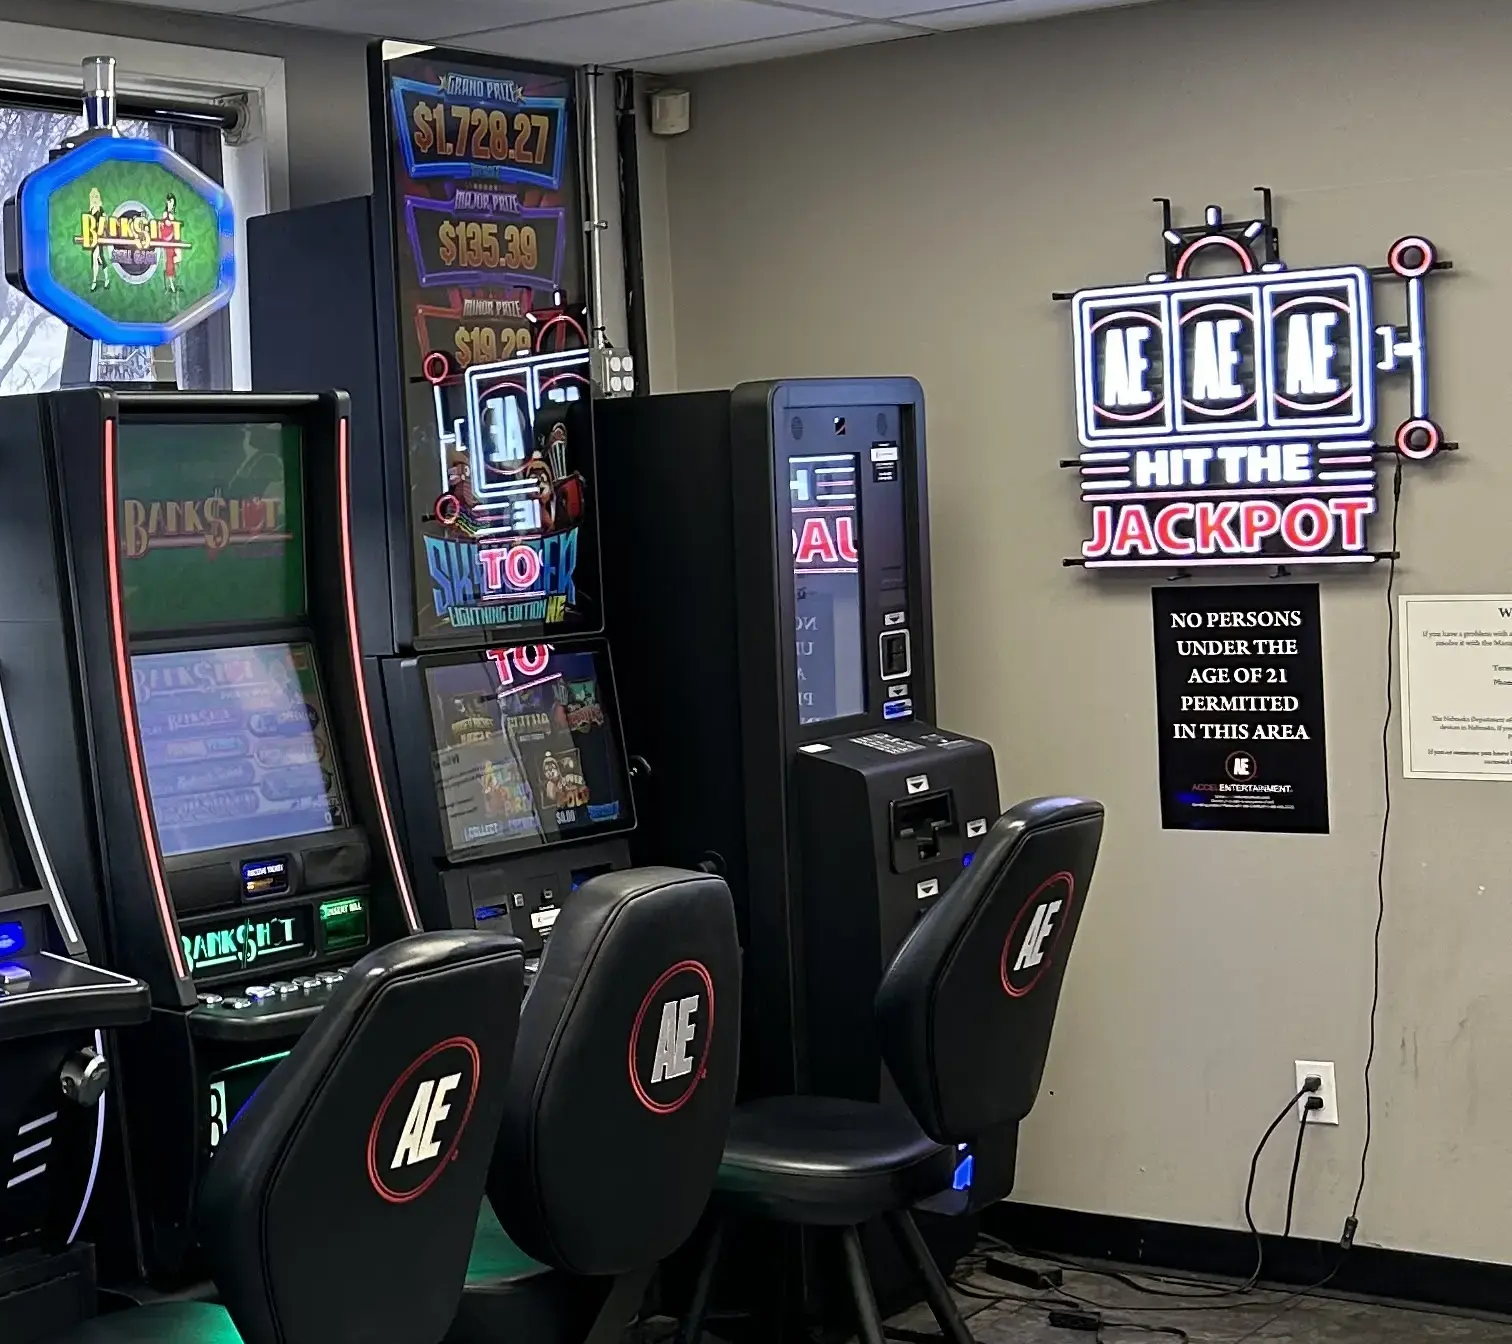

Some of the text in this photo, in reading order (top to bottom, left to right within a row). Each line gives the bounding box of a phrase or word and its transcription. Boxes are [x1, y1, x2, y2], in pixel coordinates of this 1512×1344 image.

[447, 75, 518, 103] GRAND PRIZE
[454, 189, 520, 214] MAJOR PRIZE
[438, 220, 538, 270] $135.39
[463, 299, 522, 318] MINOR PRIZE
[1104, 312, 1340, 406] AE AE AE
[1135, 443, 1312, 487] HIT THE
[1081, 497, 1376, 556] JACKPOT
[448, 604, 507, 627] LIGHTNING
[508, 599, 545, 623] EDITION
[1170, 610, 1302, 628] NO PERSONS
[1176, 639, 1298, 656] UNDER THE
[1187, 667, 1288, 683] AGE OF 21
[1180, 696, 1299, 712] PERMITTED
[1173, 723, 1311, 741] IN THIS AREA
[1233, 757, 1250, 776] AE
[1013, 900, 1062, 970] AE
[650, 995, 700, 1084] AE
[390, 1072, 461, 1169] AE
